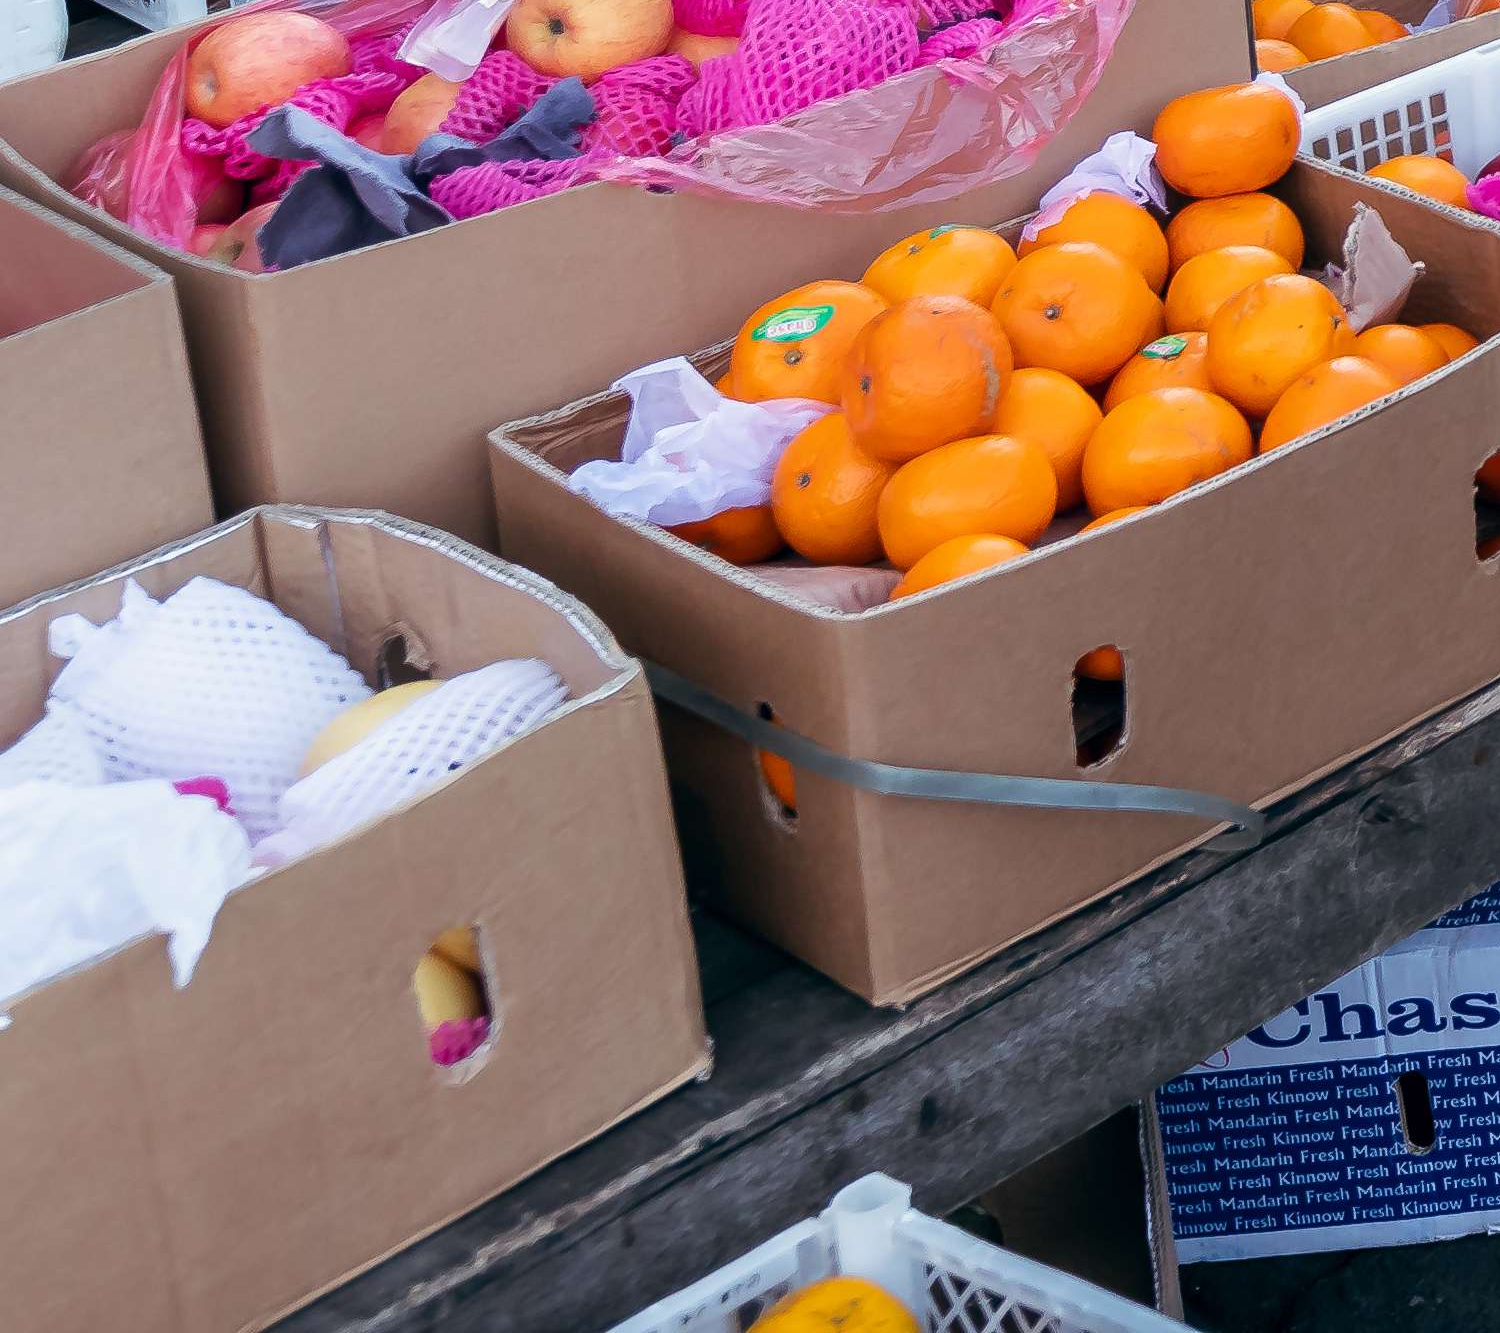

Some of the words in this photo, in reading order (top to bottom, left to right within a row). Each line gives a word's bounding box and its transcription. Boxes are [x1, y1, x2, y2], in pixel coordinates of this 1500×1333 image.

[1436, 913, 1481, 926] Fresh
[1158, 1079, 1194, 1094] resh
[1202, 1071, 1282, 1090] Mandarin
[1288, 1066, 1334, 1082] Fresh
[1340, 1058, 1420, 1077] Mandarin
[1427, 1053, 1471, 1069] Fresh
[1158, 1099, 1209, 1114] innow
[1217, 1094, 1260, 1109] Fresh
[1267, 1088, 1329, 1104] Kinnow
[1335, 1083, 1378, 1098] Fresh
[1385, 1076, 1447, 1093] Kow
[1452, 1071, 1496, 1087] Fresh
[1207, 1112, 1287, 1130] Mandarin
[1294, 1107, 1339, 1122] Fresh
[1345, 1101, 1402, 1117] Manda
[1432, 1093, 1476, 1109] Fresh
[1223, 1135, 1265, 1149] Fresh
[1272, 1128, 1335, 1145] Kinnow
[1341, 1123, 1383, 1138] Fresh
[1390, 1116, 1453, 1134] Kow
[1458, 1112, 1500, 1127] Fresh
[1213, 1152, 1293, 1171] Mandarin
[1299, 1147, 1344, 1163] Fresh
[1351, 1141, 1409, 1158] Manda
[1437, 1134, 1482, 1149] Fresh
[1228, 1175, 1271, 1190] Fresh
[1278, 1168, 1340, 1185] Kinnow
[1345, 1163, 1389, 1178] Fresh
[1395, 1156, 1458, 1174] Kinnow
[1219, 1192, 1298, 1211] Mandarin
[1305, 1187, 1349, 1202] Fresh
[1356, 1179, 1436, 1197] Mandarin
[1442, 1174, 1487, 1189] Fresh
[1234, 1216, 1276, 1230] Fresh
[1284, 1209, 1345, 1225] Kinnow
[1351, 1204, 1394, 1219] Fresh
[1400, 1197, 1463, 1214] Kinnow
